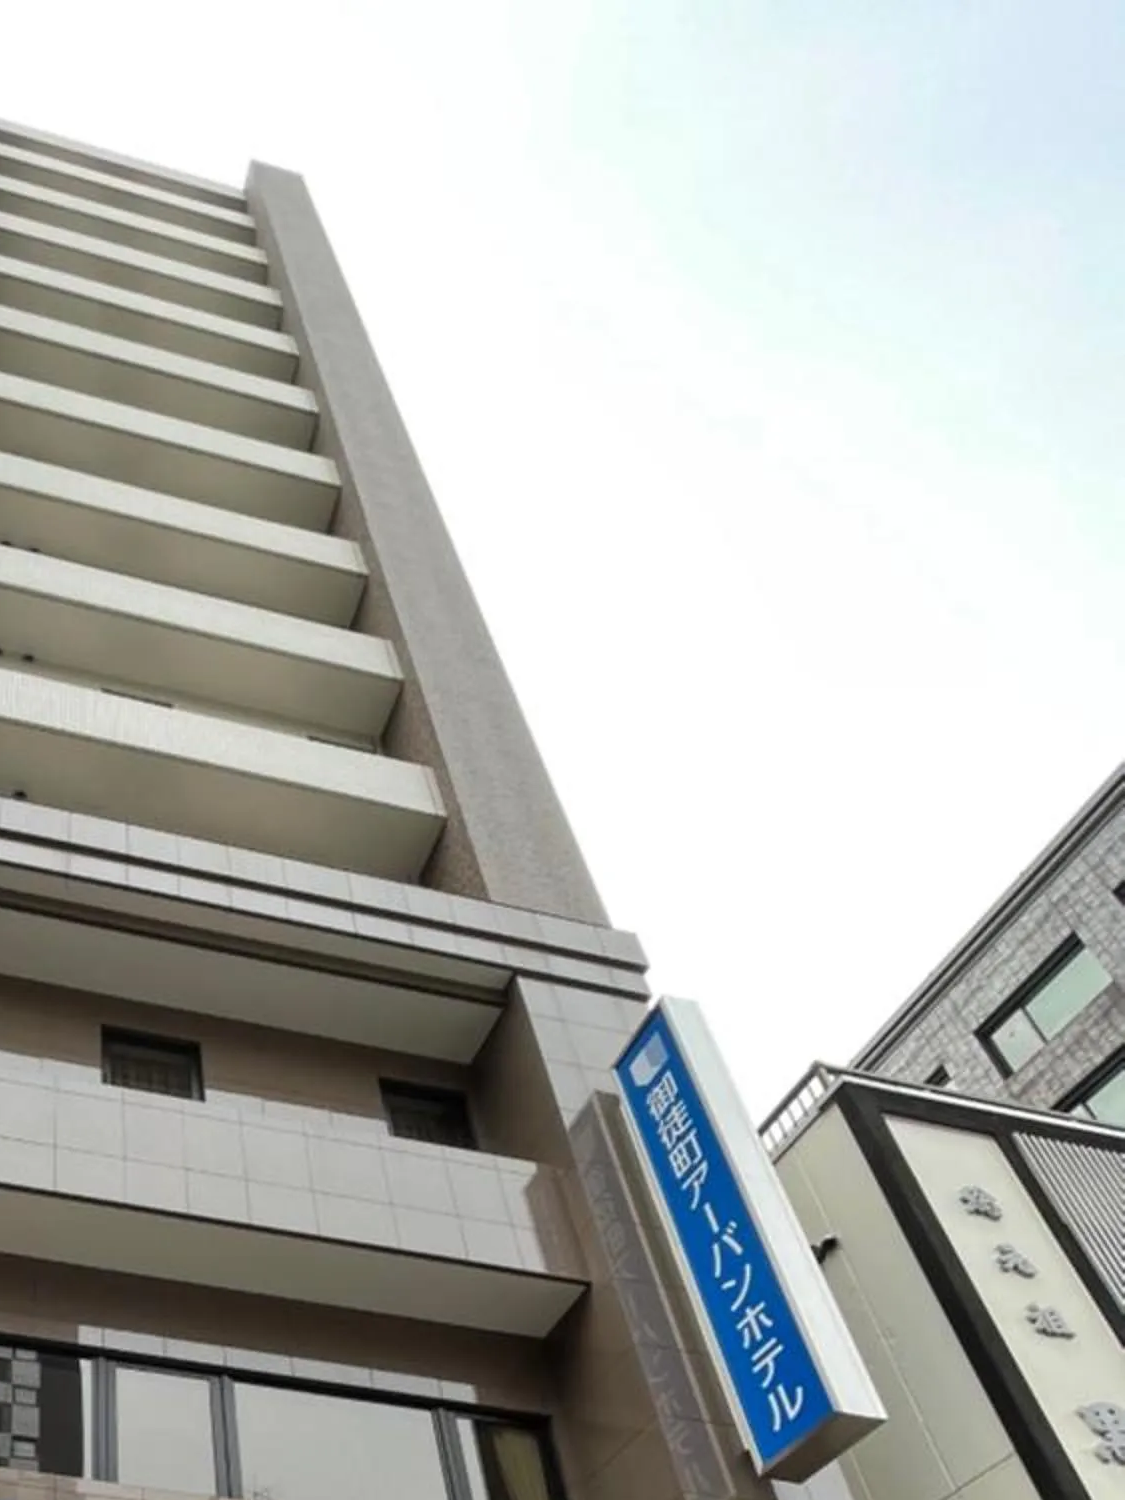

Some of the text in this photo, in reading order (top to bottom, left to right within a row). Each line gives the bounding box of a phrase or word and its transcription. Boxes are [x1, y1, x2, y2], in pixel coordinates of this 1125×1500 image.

[646, 1069, 804, 1432] 御徒町アーバンホテル
